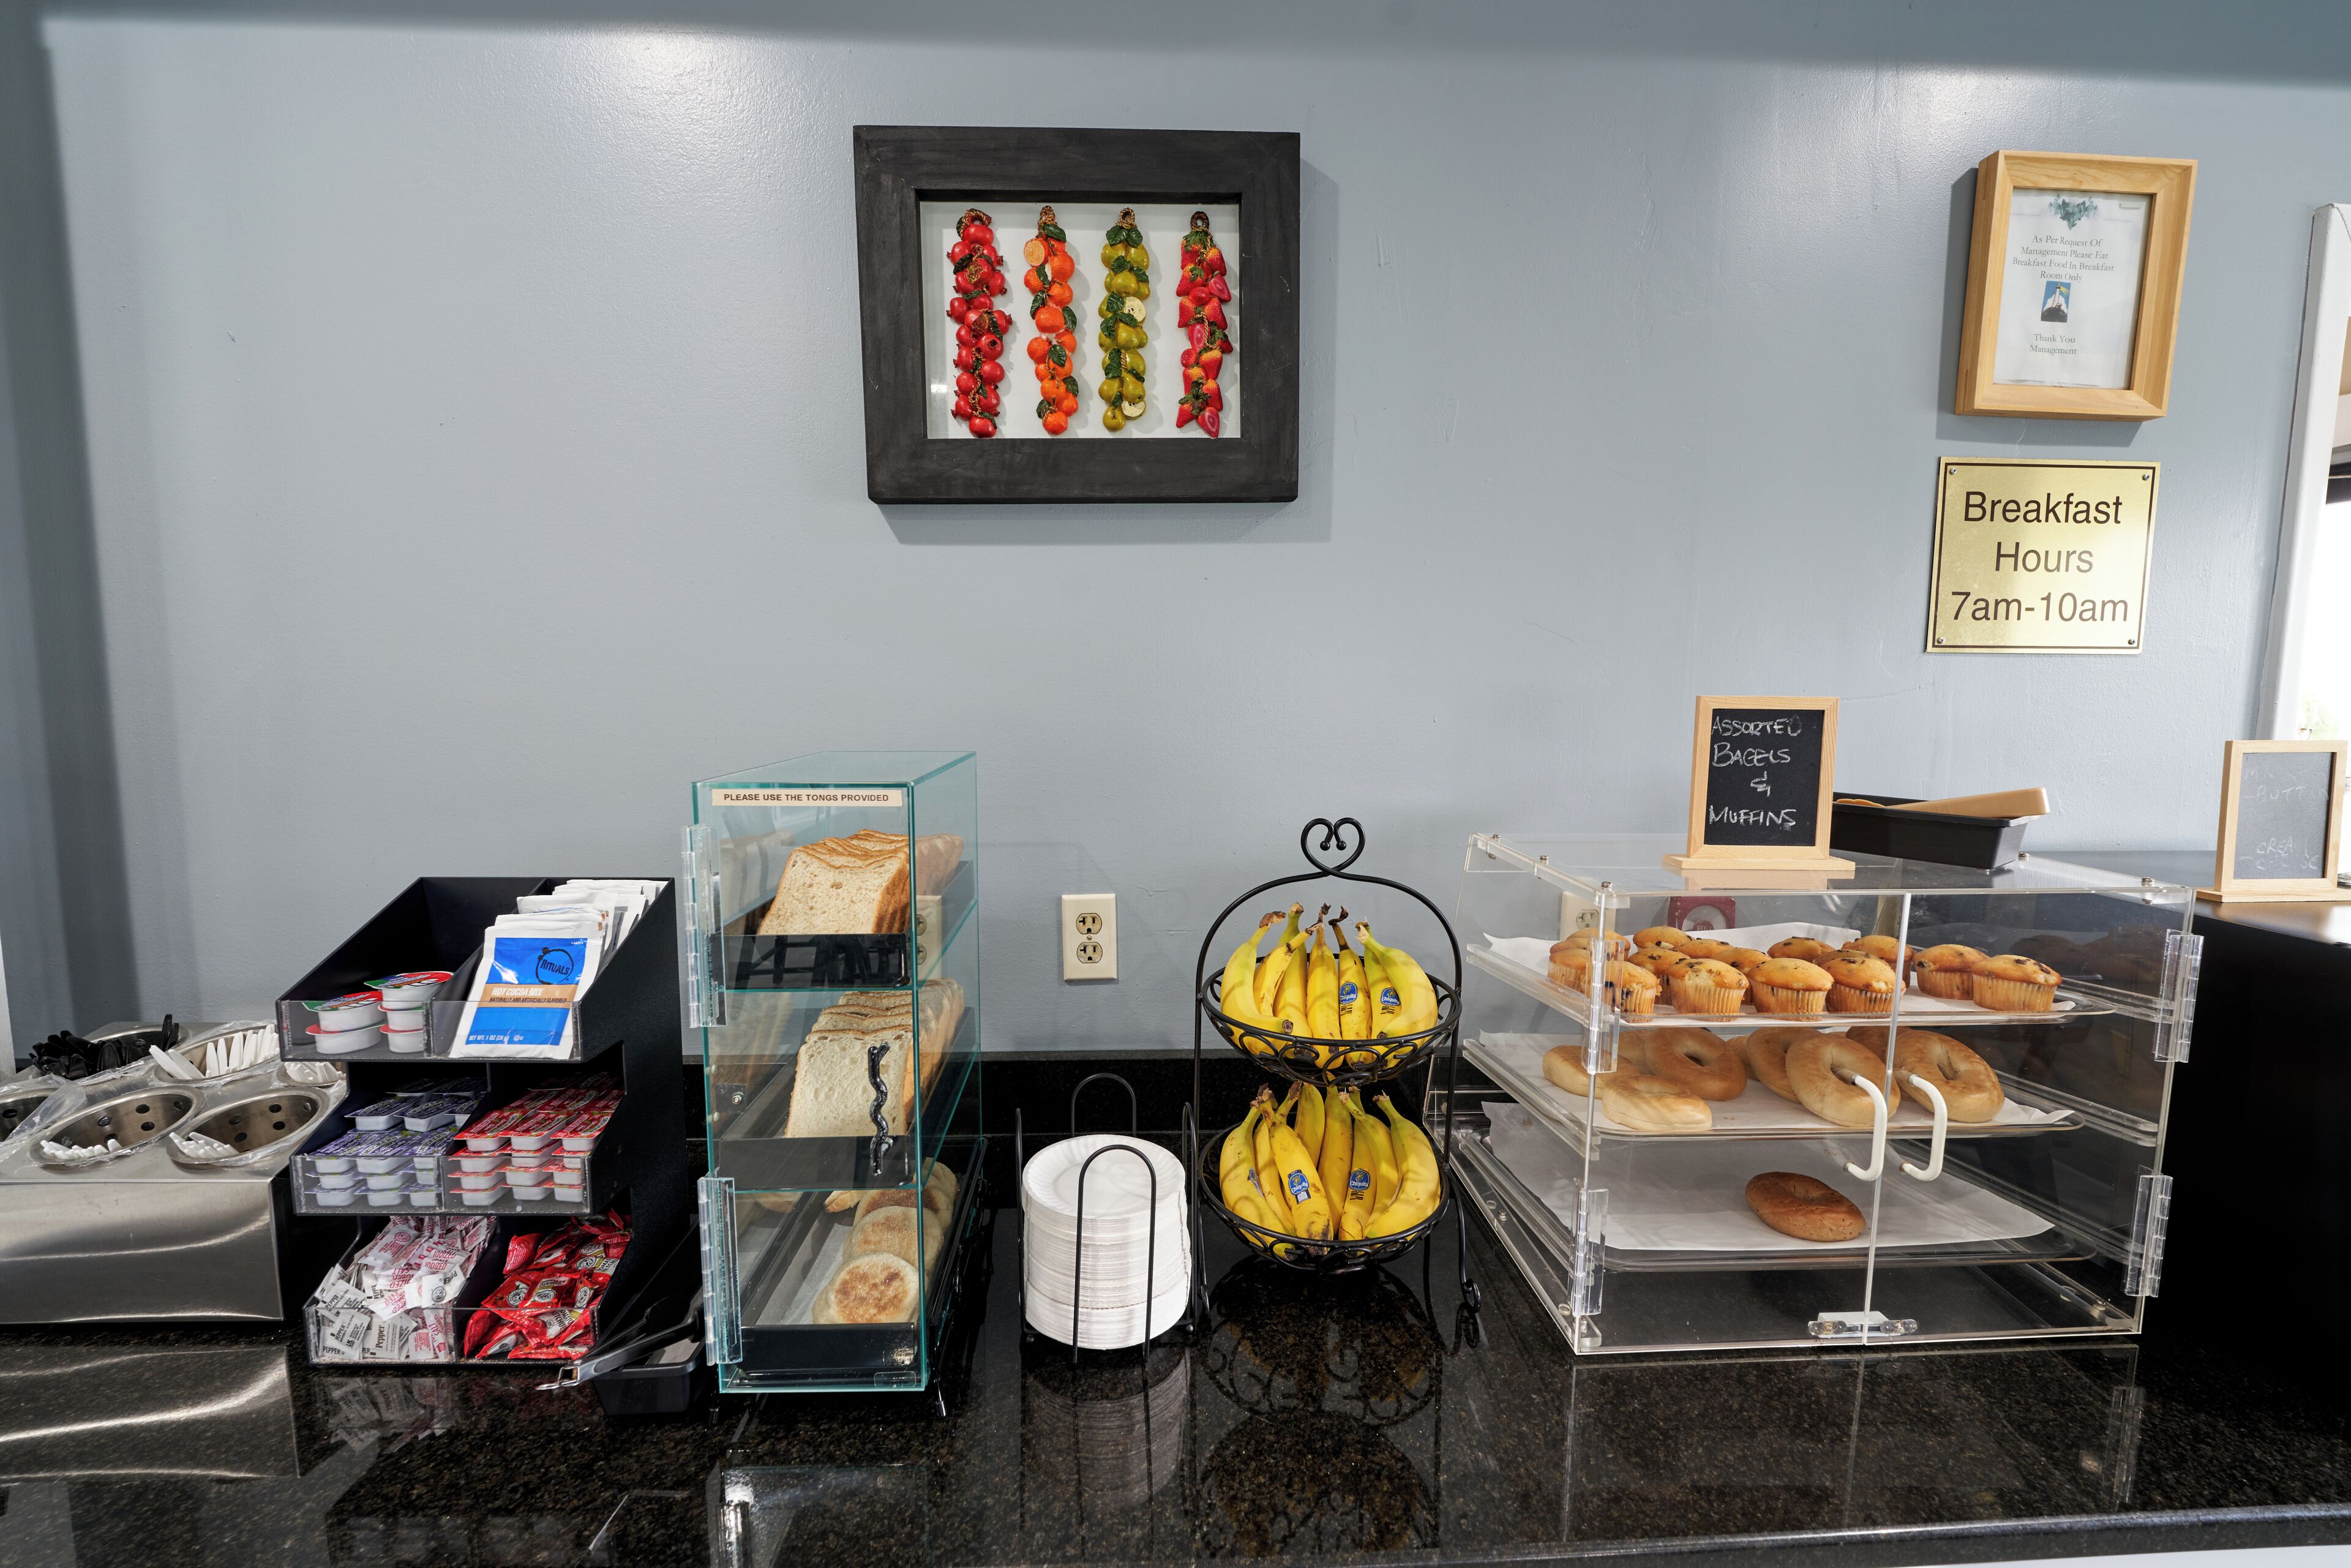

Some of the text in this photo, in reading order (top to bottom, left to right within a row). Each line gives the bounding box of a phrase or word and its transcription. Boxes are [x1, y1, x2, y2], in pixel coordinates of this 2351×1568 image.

[2031, 235, 2043, 244] As
[2045, 235, 2058, 244] Per
[2060, 236, 2088, 248] Request
[2021, 246, 2109, 260] Management Please Eat
[2012, 257, 2047, 267] Breakfast
[2049, 259, 2068, 268] Food
[2079, 262, 2115, 271] Breakfast
[2040, 270, 2083, 283] Room Only
[2033, 333, 2057, 342] Thank
[2030, 345, 2077, 355] Management
[1964, 490, 2123, 525] Breakfast
[1995, 541, 2094, 573] Hours
[1951, 591, 2129, 622] 7am-10am
[1711, 715, 1802, 737] ASSORTED
[1712, 741, 1791, 767] BAGELS
[1708, 805, 1797, 828] MUFFINS
[540, 959, 570, 975] RITUALS
[491, 987, 544, 996] HOT COCOA MIX
[1381, 996, 1400, 1005] Chiquita
[1291, 1182, 1309, 1193] Chiquita
[425, 1262, 447, 1270] IODIZED
[371, 1284, 380, 1300] PEPPER
[325, 1294, 339, 1310] PEPPER
[335, 1324, 347, 1341] PEPPER
[375, 1324, 385, 1349] Pepper
[323, 1345, 342, 1356] PEPPER
